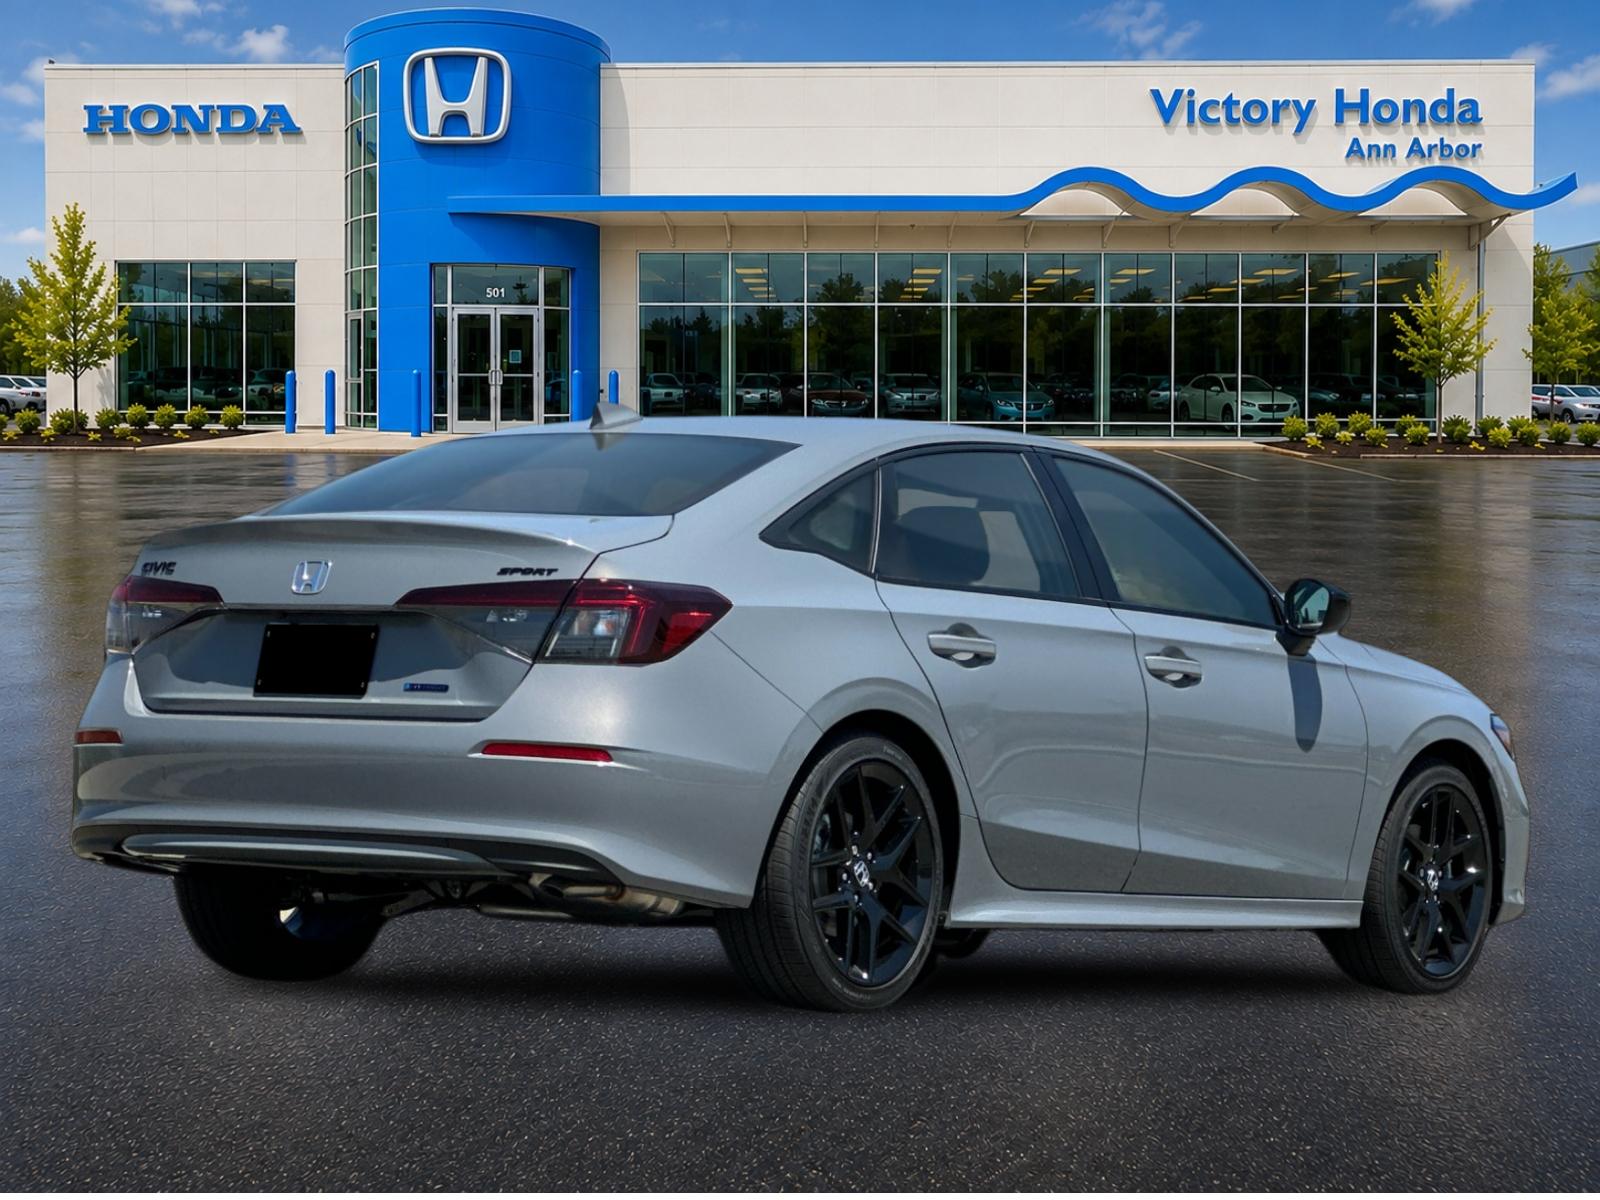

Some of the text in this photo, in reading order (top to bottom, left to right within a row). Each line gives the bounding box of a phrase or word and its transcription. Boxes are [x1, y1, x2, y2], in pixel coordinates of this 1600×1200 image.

[83, 103, 303, 136] HONDA
[1150, 87, 1484, 135] Victory Honda
[1346, 137, 1483, 160] Ann Arbor
[485, 287, 505, 298] 501
[497, 567, 559, 577] SPORT
